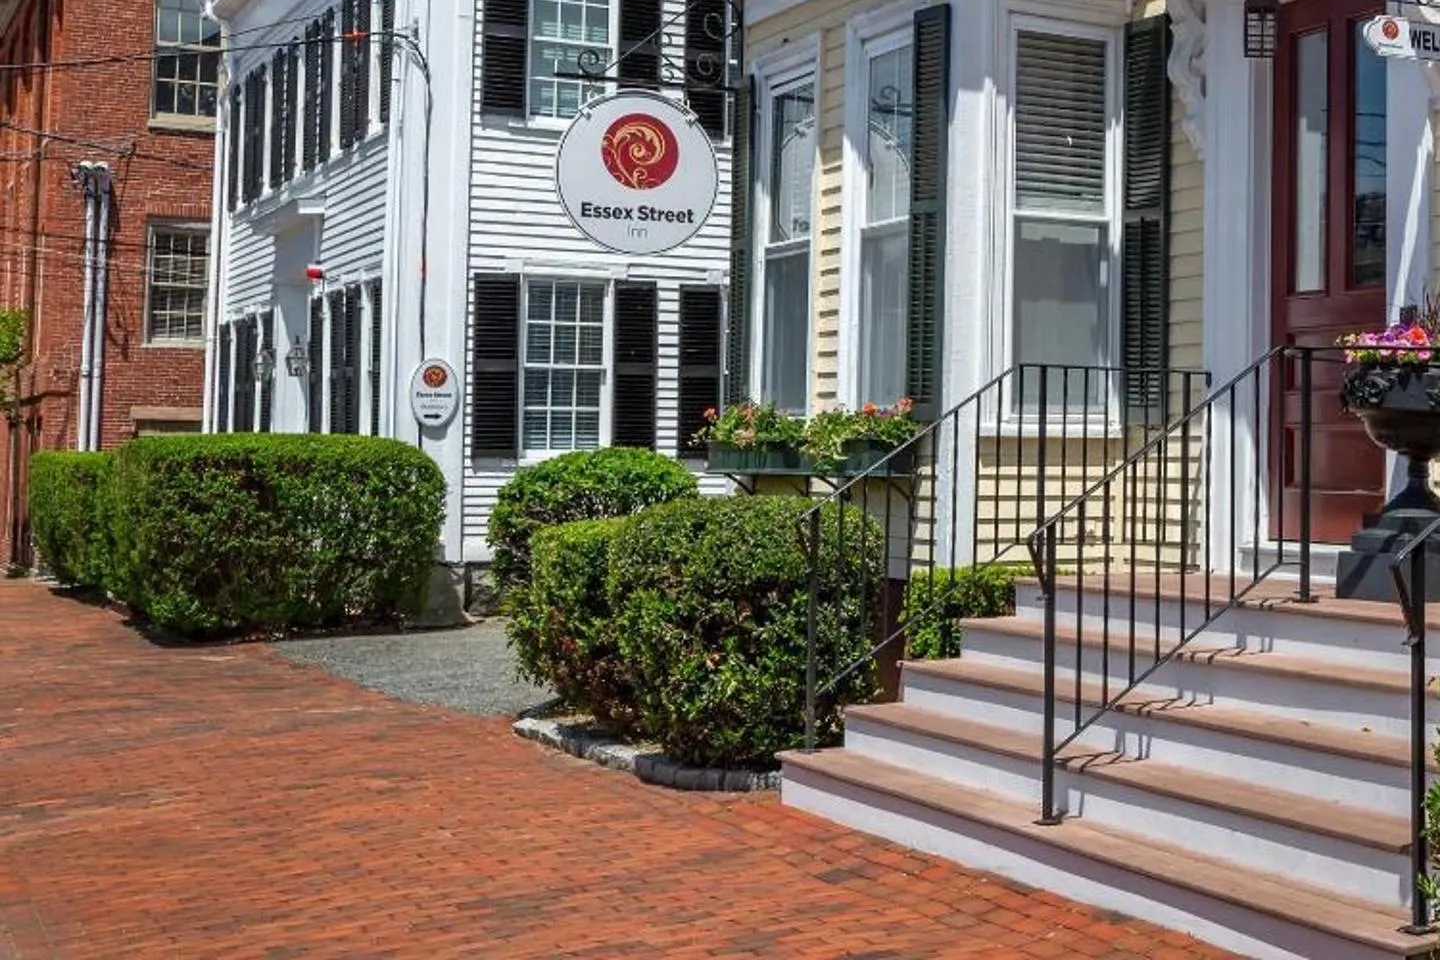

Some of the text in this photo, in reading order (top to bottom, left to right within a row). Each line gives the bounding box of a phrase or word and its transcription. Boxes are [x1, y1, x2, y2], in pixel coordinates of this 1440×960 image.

[580, 201, 694, 224] Essex Street
[627, 224, 648, 238] Inn
